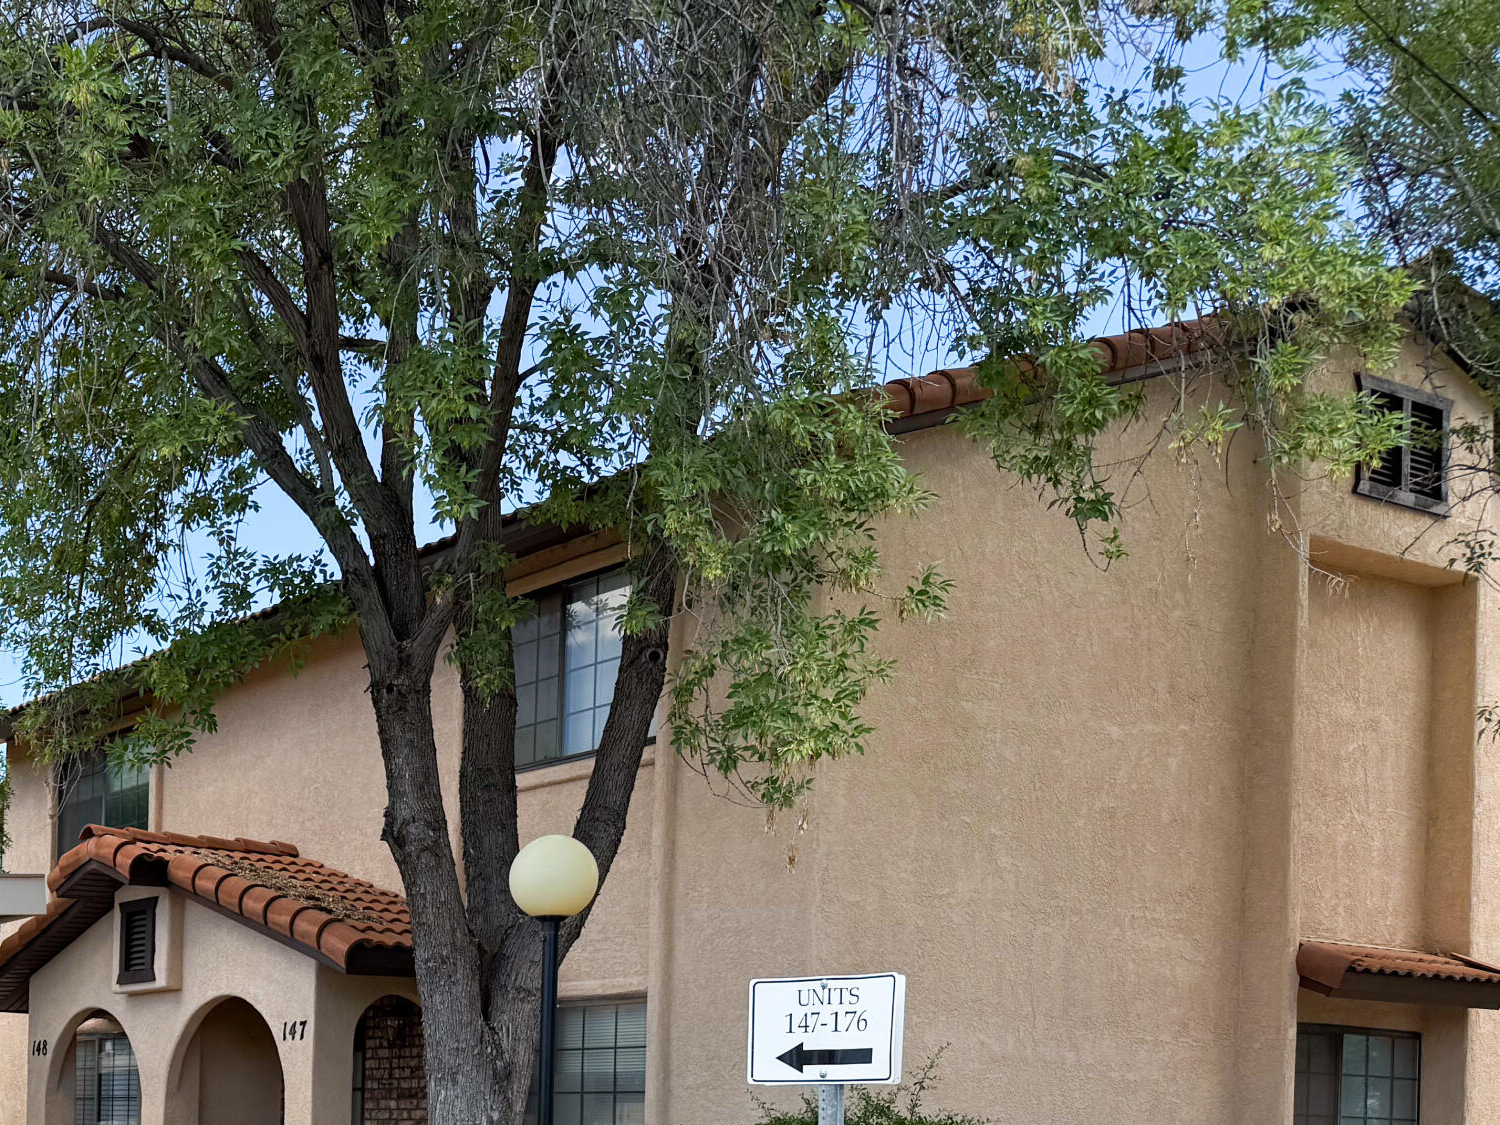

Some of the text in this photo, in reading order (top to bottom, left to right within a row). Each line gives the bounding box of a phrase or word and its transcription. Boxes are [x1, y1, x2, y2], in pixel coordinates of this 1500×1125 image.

[797, 987, 860, 1006] UNITS
[282, 1020, 307, 1041] 147
[784, 1010, 868, 1034] 147-176
[32, 1040, 48, 1056] 148
